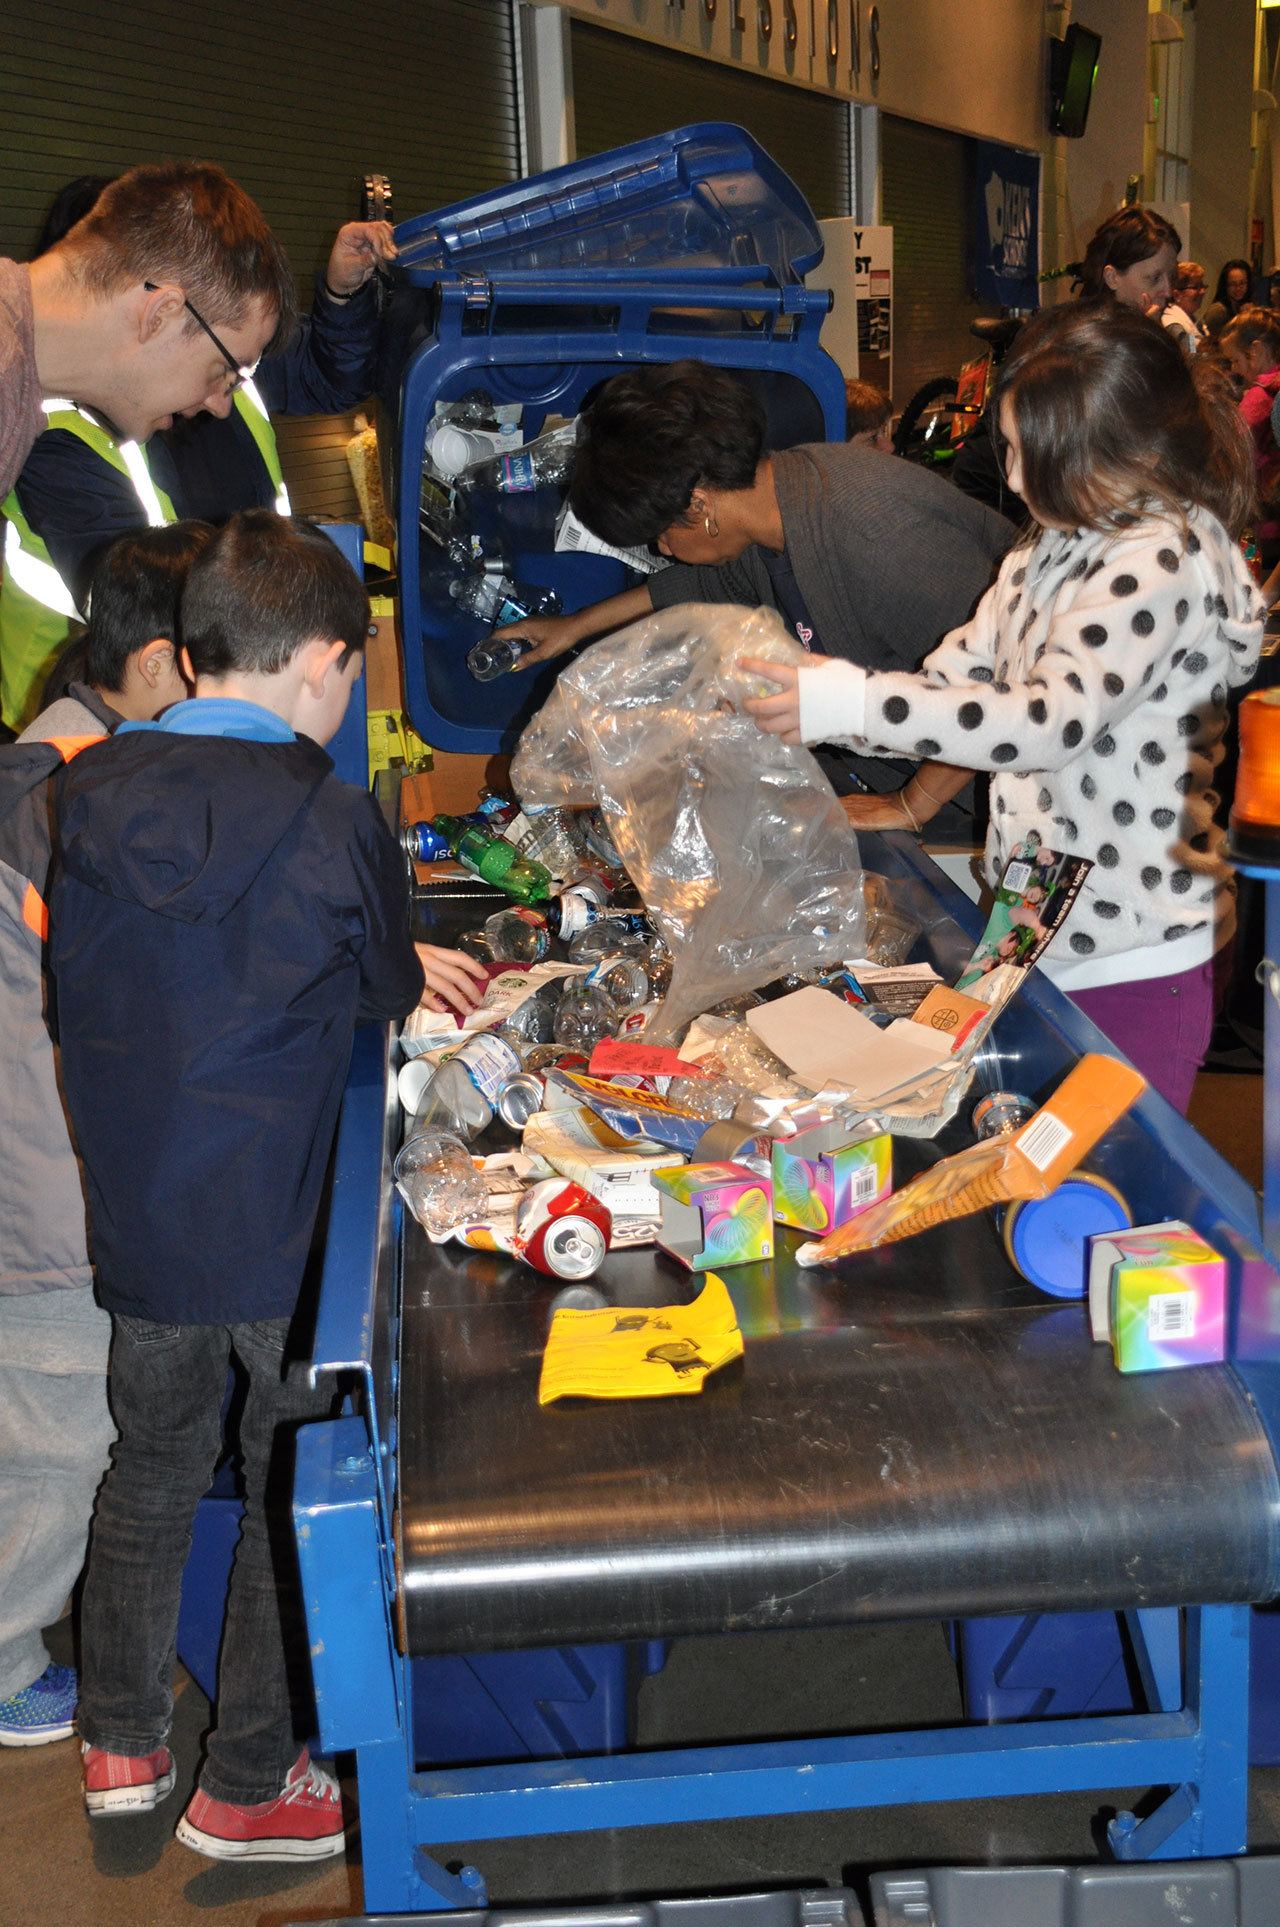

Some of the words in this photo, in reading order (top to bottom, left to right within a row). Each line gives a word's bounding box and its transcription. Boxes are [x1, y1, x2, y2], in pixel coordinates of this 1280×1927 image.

[1072, 862, 1089, 887] Join
[1067, 888, 1076, 897] a
[1052, 898, 1073, 927] team
[1029, 928, 1055, 961] where
